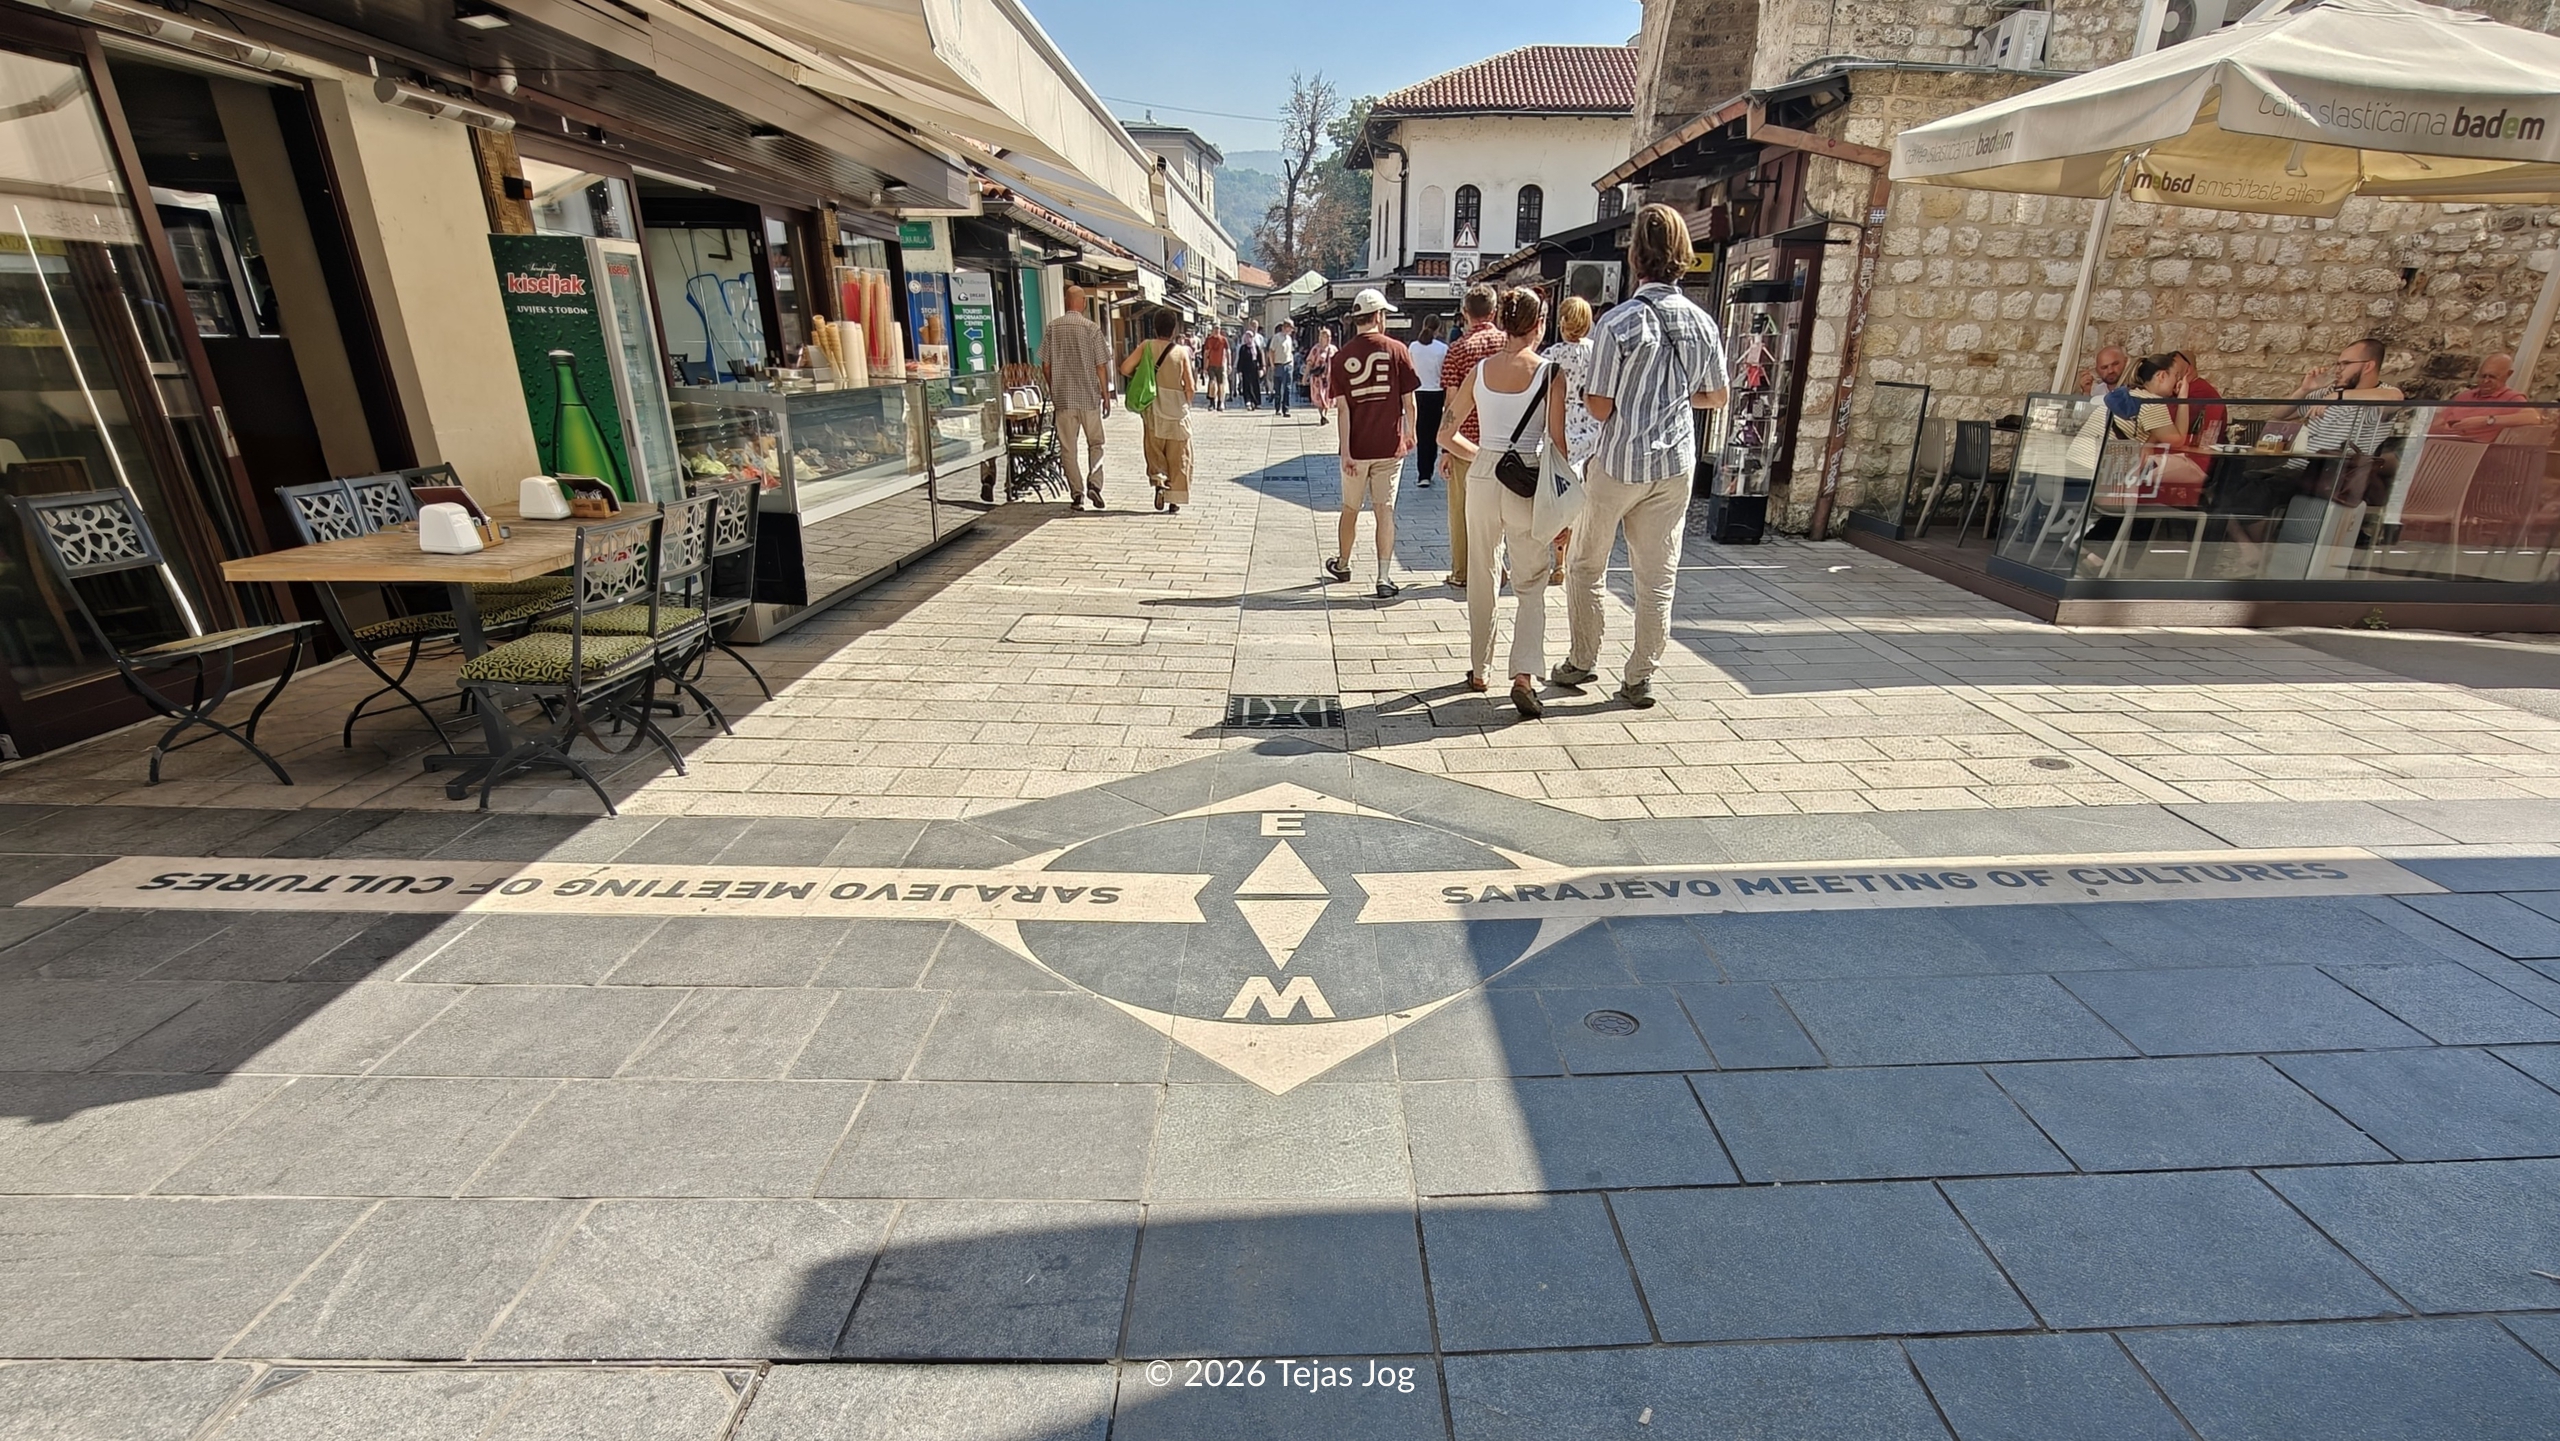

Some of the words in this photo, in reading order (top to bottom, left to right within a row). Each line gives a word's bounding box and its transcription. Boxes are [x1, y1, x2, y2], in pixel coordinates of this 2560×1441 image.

[2319, 98, 2448, 136] slastičarna
[2452, 106, 2546, 141] badem
[1975, 129, 2014, 156] badem
[507, 272, 587, 298] kiseljak
[517, 305, 548, 315] UVIJEK
[548, 306, 554, 314] S
[555, 306, 589, 315] TOBOM
[1260, 812, 1307, 837] E
[136, 872, 455, 894] CULTURES
[457, 877, 543, 897] OF
[552, 878, 814, 899] MEETING
[829, 882, 1125, 905] SARAJEVO
[1440, 879, 1722, 905] SARAJEVO
[1738, 871, 1978, 896] MEETING
[1986, 869, 2054, 888] OF
[2069, 862, 2349, 887] CULTURES
